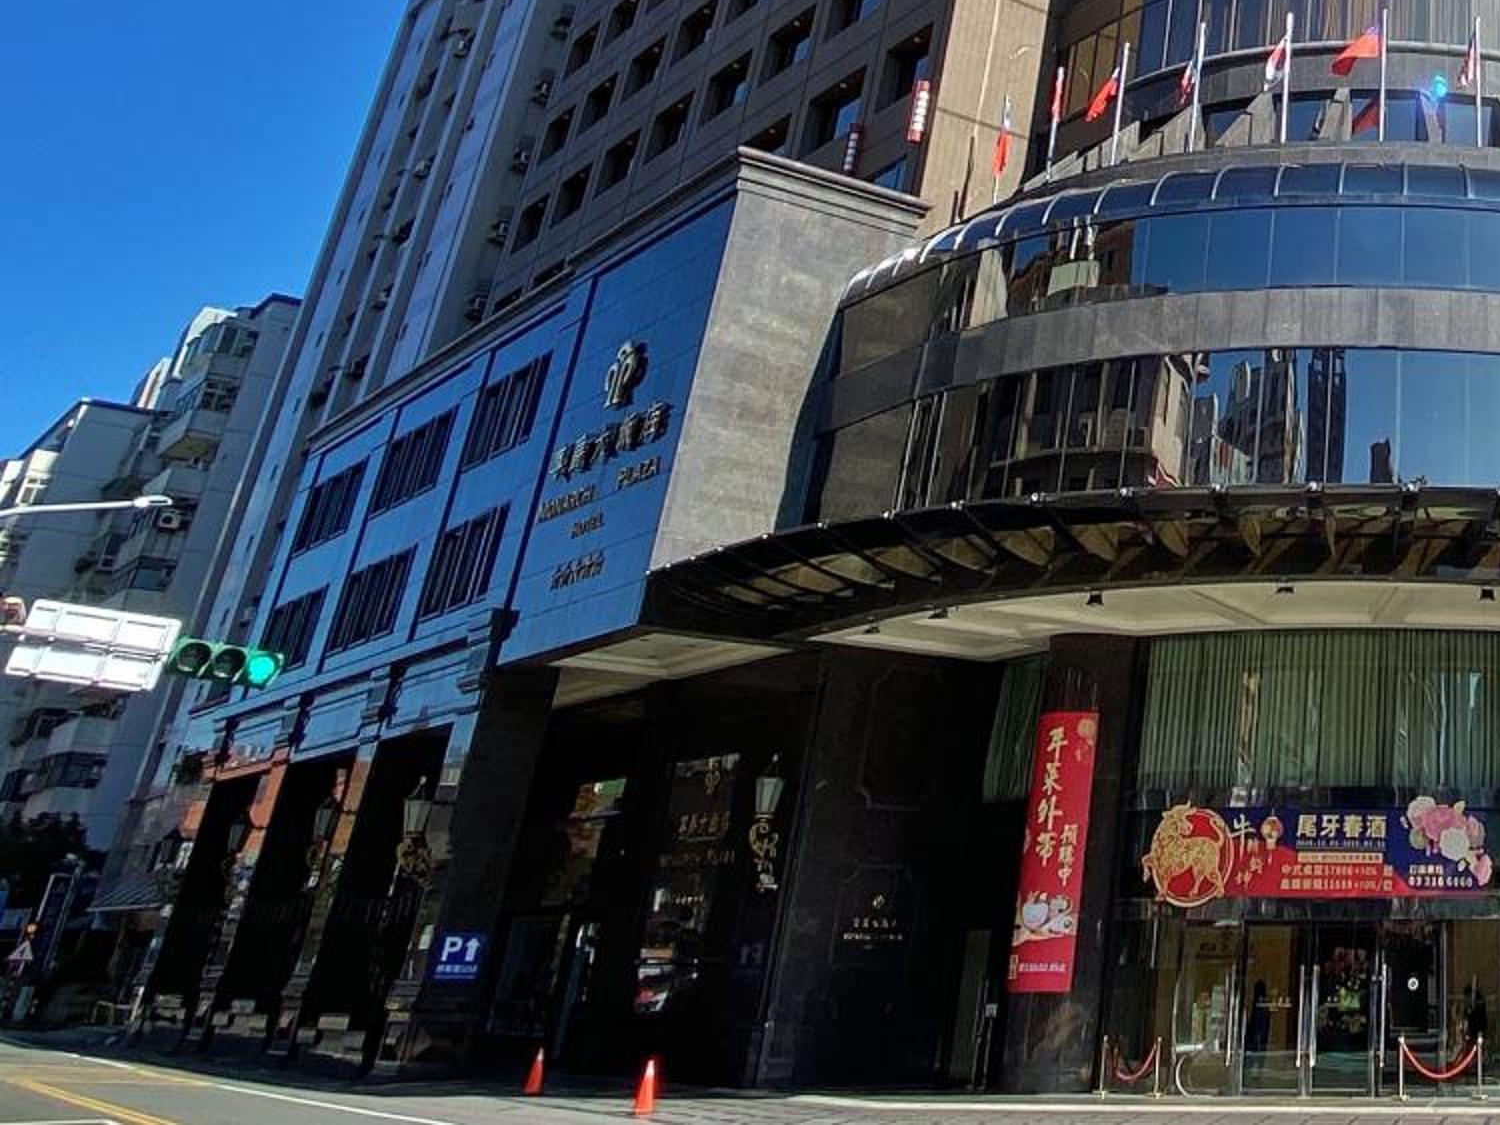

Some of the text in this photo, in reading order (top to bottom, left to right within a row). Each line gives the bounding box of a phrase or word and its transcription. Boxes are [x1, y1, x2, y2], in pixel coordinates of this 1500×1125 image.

[1035, 726, 1069, 867] 年菜外帶
[1296, 814, 1387, 838] 尾牙春酒
[441, 936, 463, 962] P
